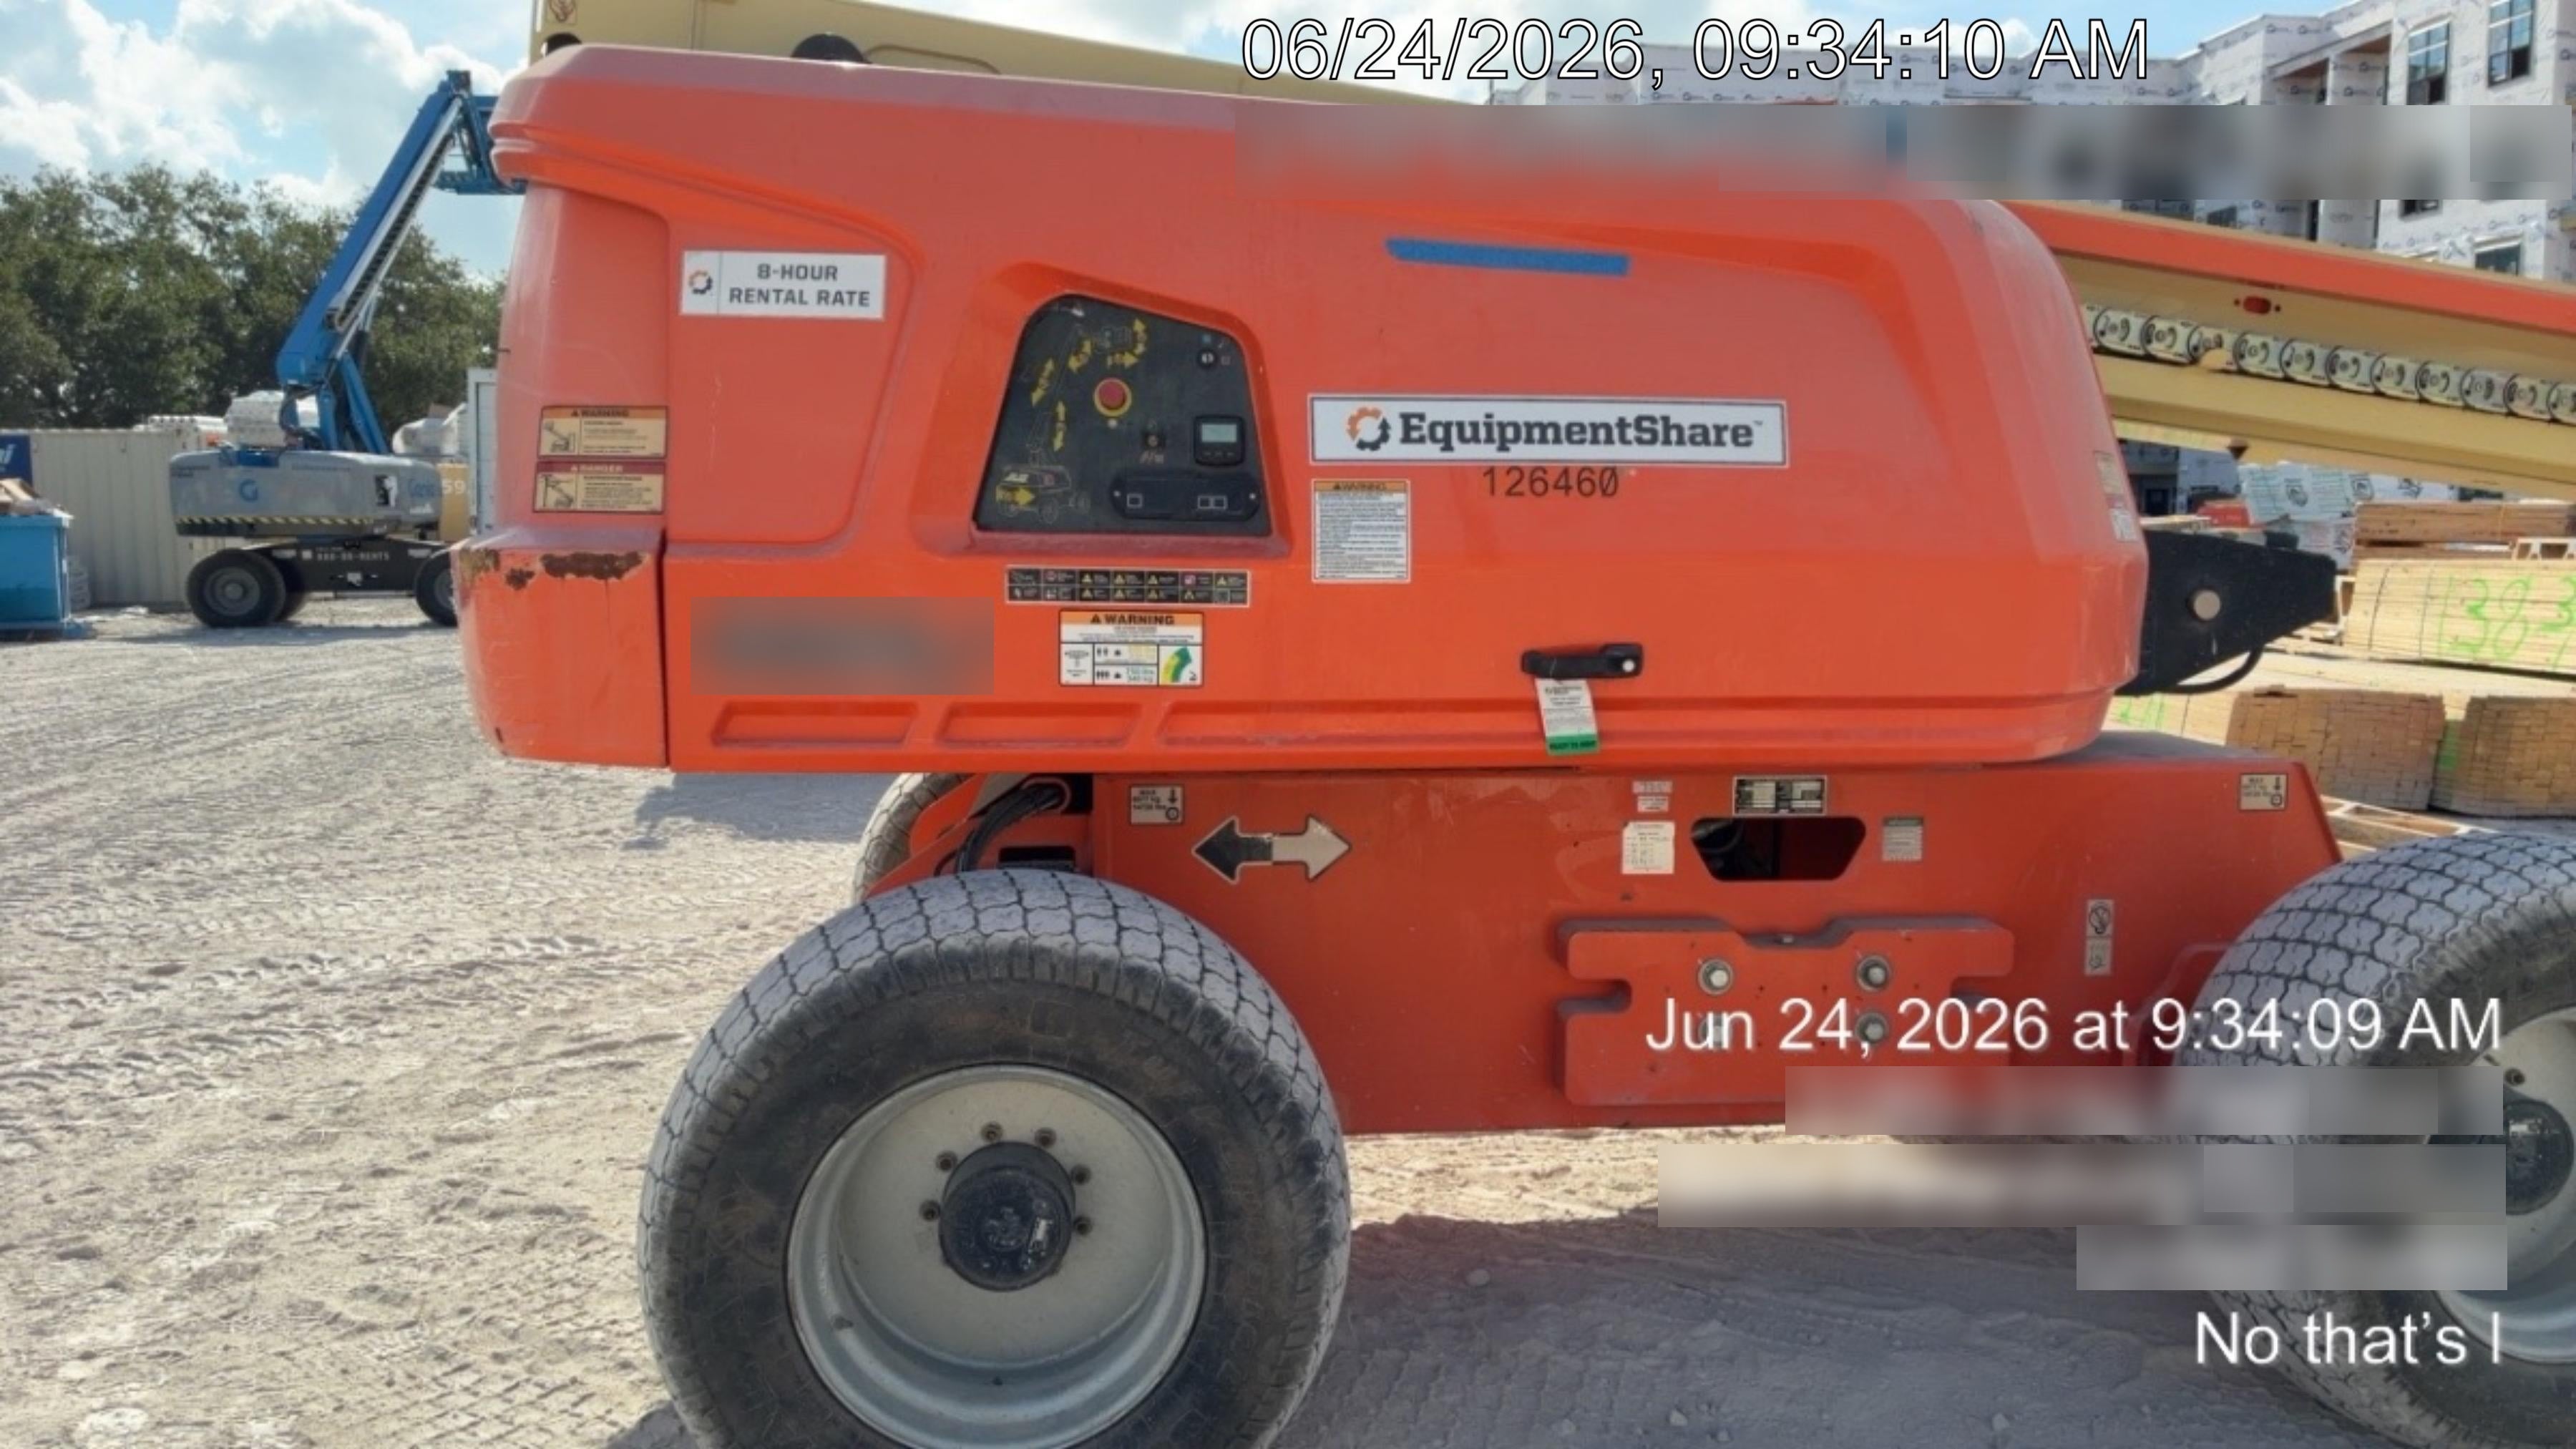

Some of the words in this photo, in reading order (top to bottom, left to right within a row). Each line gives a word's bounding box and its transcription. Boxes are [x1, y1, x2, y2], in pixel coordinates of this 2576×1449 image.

[757, 263, 838, 281] 8-HOUR
[729, 287, 808, 306] RENTAL
[816, 288, 870, 307] RATE
[1482, 465, 1620, 497] 126460
[1103, 615, 1175, 625] WARNING
